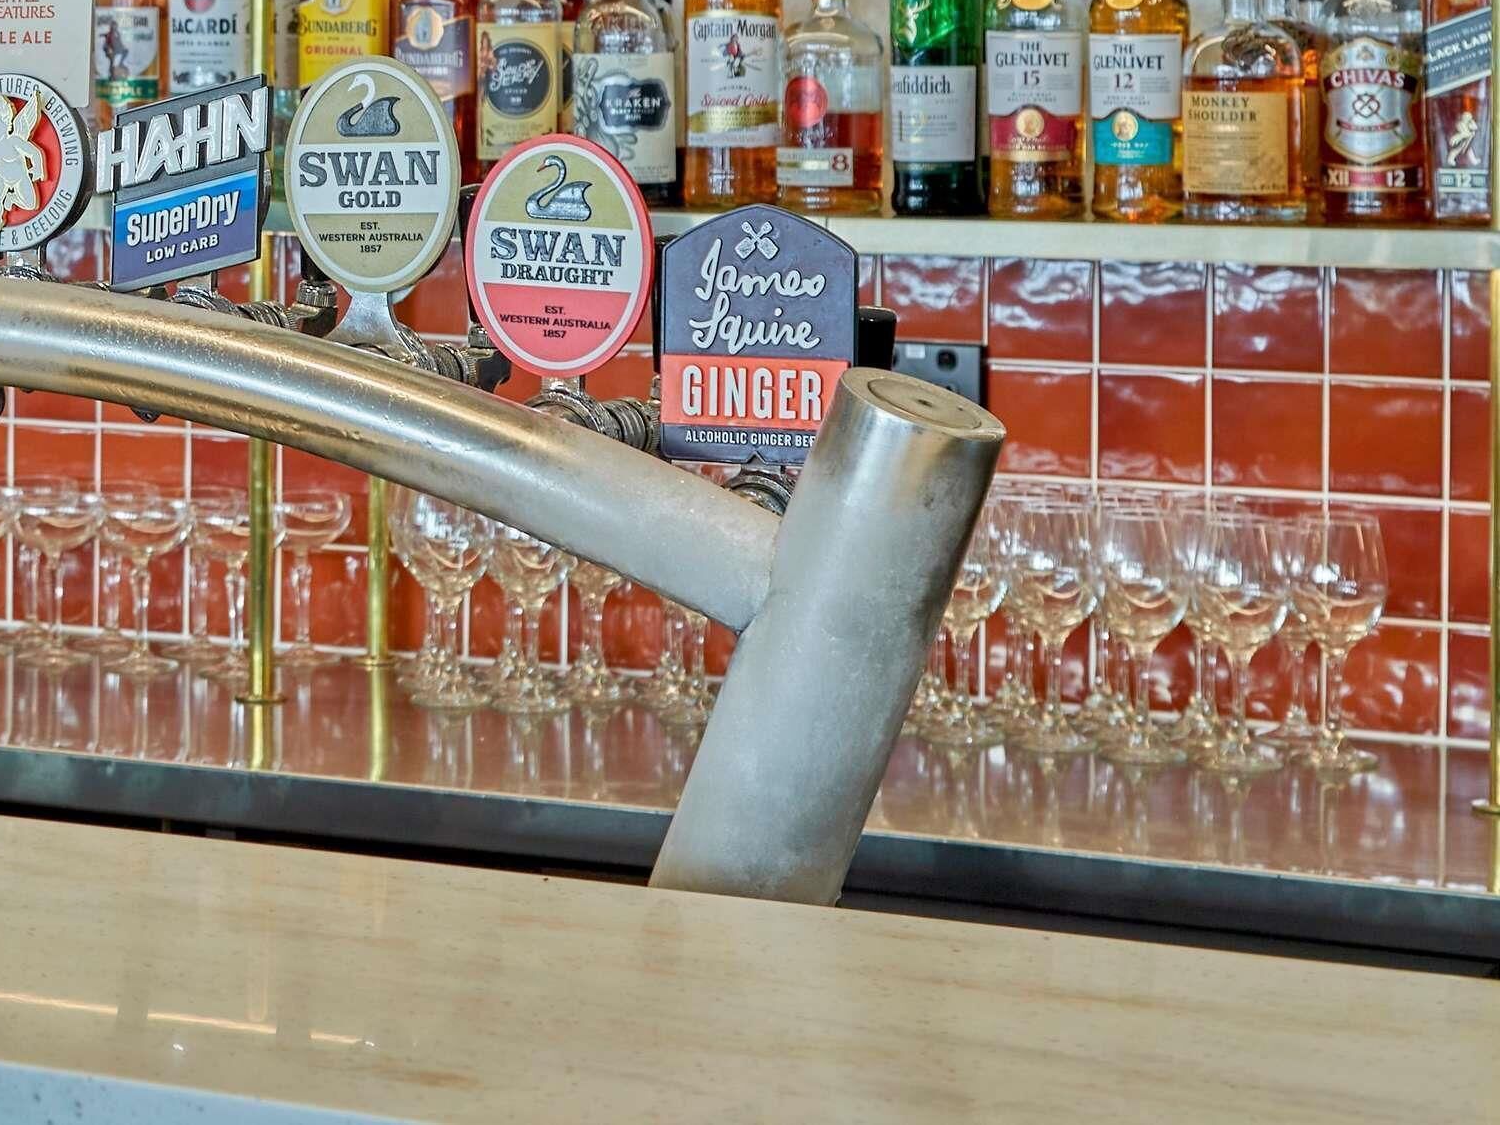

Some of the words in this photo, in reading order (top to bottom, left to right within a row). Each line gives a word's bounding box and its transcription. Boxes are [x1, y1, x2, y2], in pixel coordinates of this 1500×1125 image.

[299, 14, 379, 37] BUNDABERG
[693, 20, 734, 41] Captain
[737, 19, 776, 41] Morgan
[22, 30, 52, 44] ALE
[305, 45, 364, 55] ORIGINAL
[1020, 42, 1042, 52] THE
[1113, 44, 1134, 55] THE
[996, 52, 1069, 68] GLENLIVET
[1093, 55, 1165, 70] GLENLIVET
[1022, 70, 1041, 86] 15
[1114, 73, 1134, 89] 12
[1331, 70, 1405, 88] CHIVAS
[606, 97, 661, 108] KRAKEN
[1191, 96, 1250, 108] MONKEY
[1187, 110, 1258, 122] SHOULDER
[45, 95, 79, 167] BREWING
[96, 85, 269, 194] HAHN
[298, 150, 441, 187] SWAN
[831, 153, 850, 171] 8
[1385, 170, 1406, 187] 12
[338, 190, 401, 208] GOLD
[11, 230, 19, 245] &
[24, 189, 72, 241] GEELONG
[126, 190, 241, 248] SuperDry
[360, 221, 381, 231] EST.
[319, 233, 366, 242] WESTERN
[368, 233, 424, 242] AUSTRALIA
[146, 242, 177, 263] LOW
[180, 233, 219, 256] CARB
[360, 245, 382, 253] 1857
[490, 226, 626, 267] SWAN
[500, 263, 613, 286] DRAUGHT
[694, 237, 826, 303] James
[544, 305, 566, 315] EST.
[500, 313, 550, 326] WESTERN
[552, 317, 612, 330] AUSTRALIA
[688, 291, 821, 355] Squire
[543, 329, 567, 338] 1857
[681, 364, 822, 421] GINGER
[685, 430, 747, 445] ALCOHOLIC
[750, 433, 792, 447] GINGER
